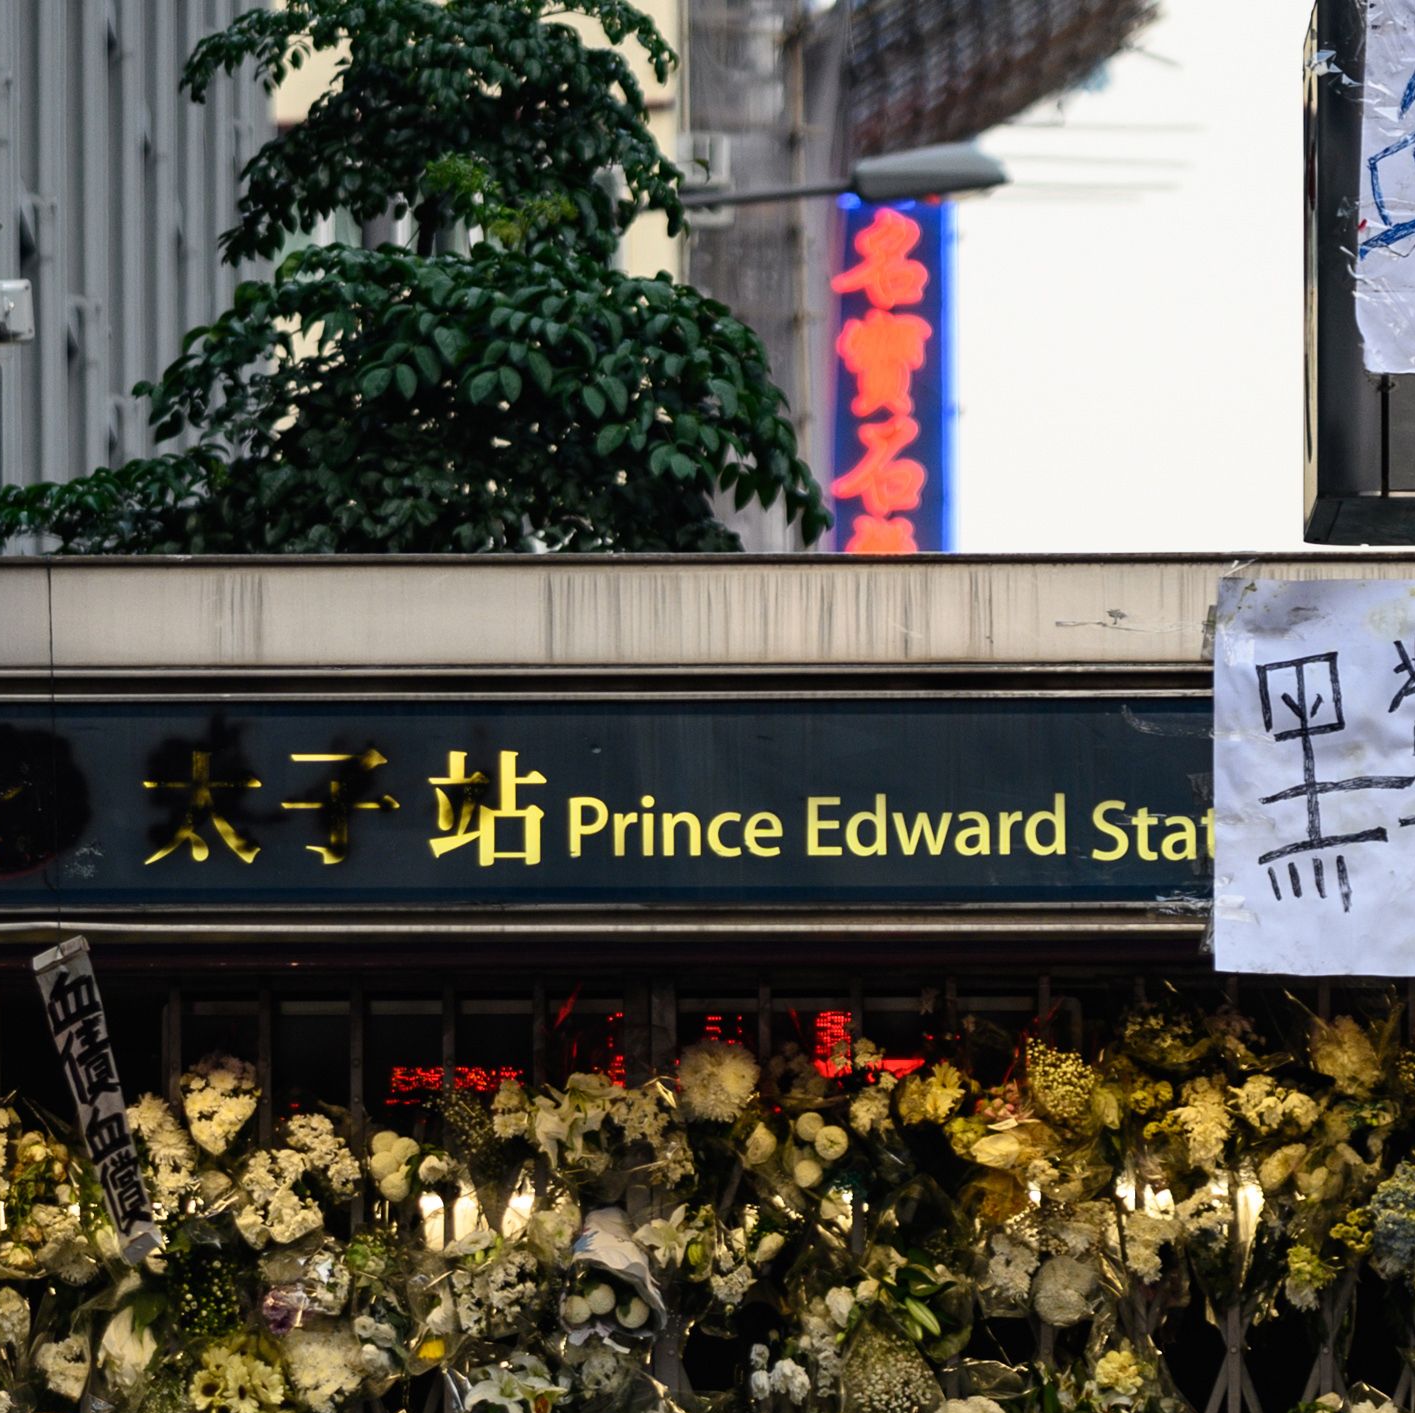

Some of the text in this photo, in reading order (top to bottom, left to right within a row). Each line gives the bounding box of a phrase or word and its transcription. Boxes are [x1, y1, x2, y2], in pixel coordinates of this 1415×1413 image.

[569, 795, 784, 859] Prince
[806, 792, 1068, 858] Edward
[48, 969, 154, 1236] 血債血償
